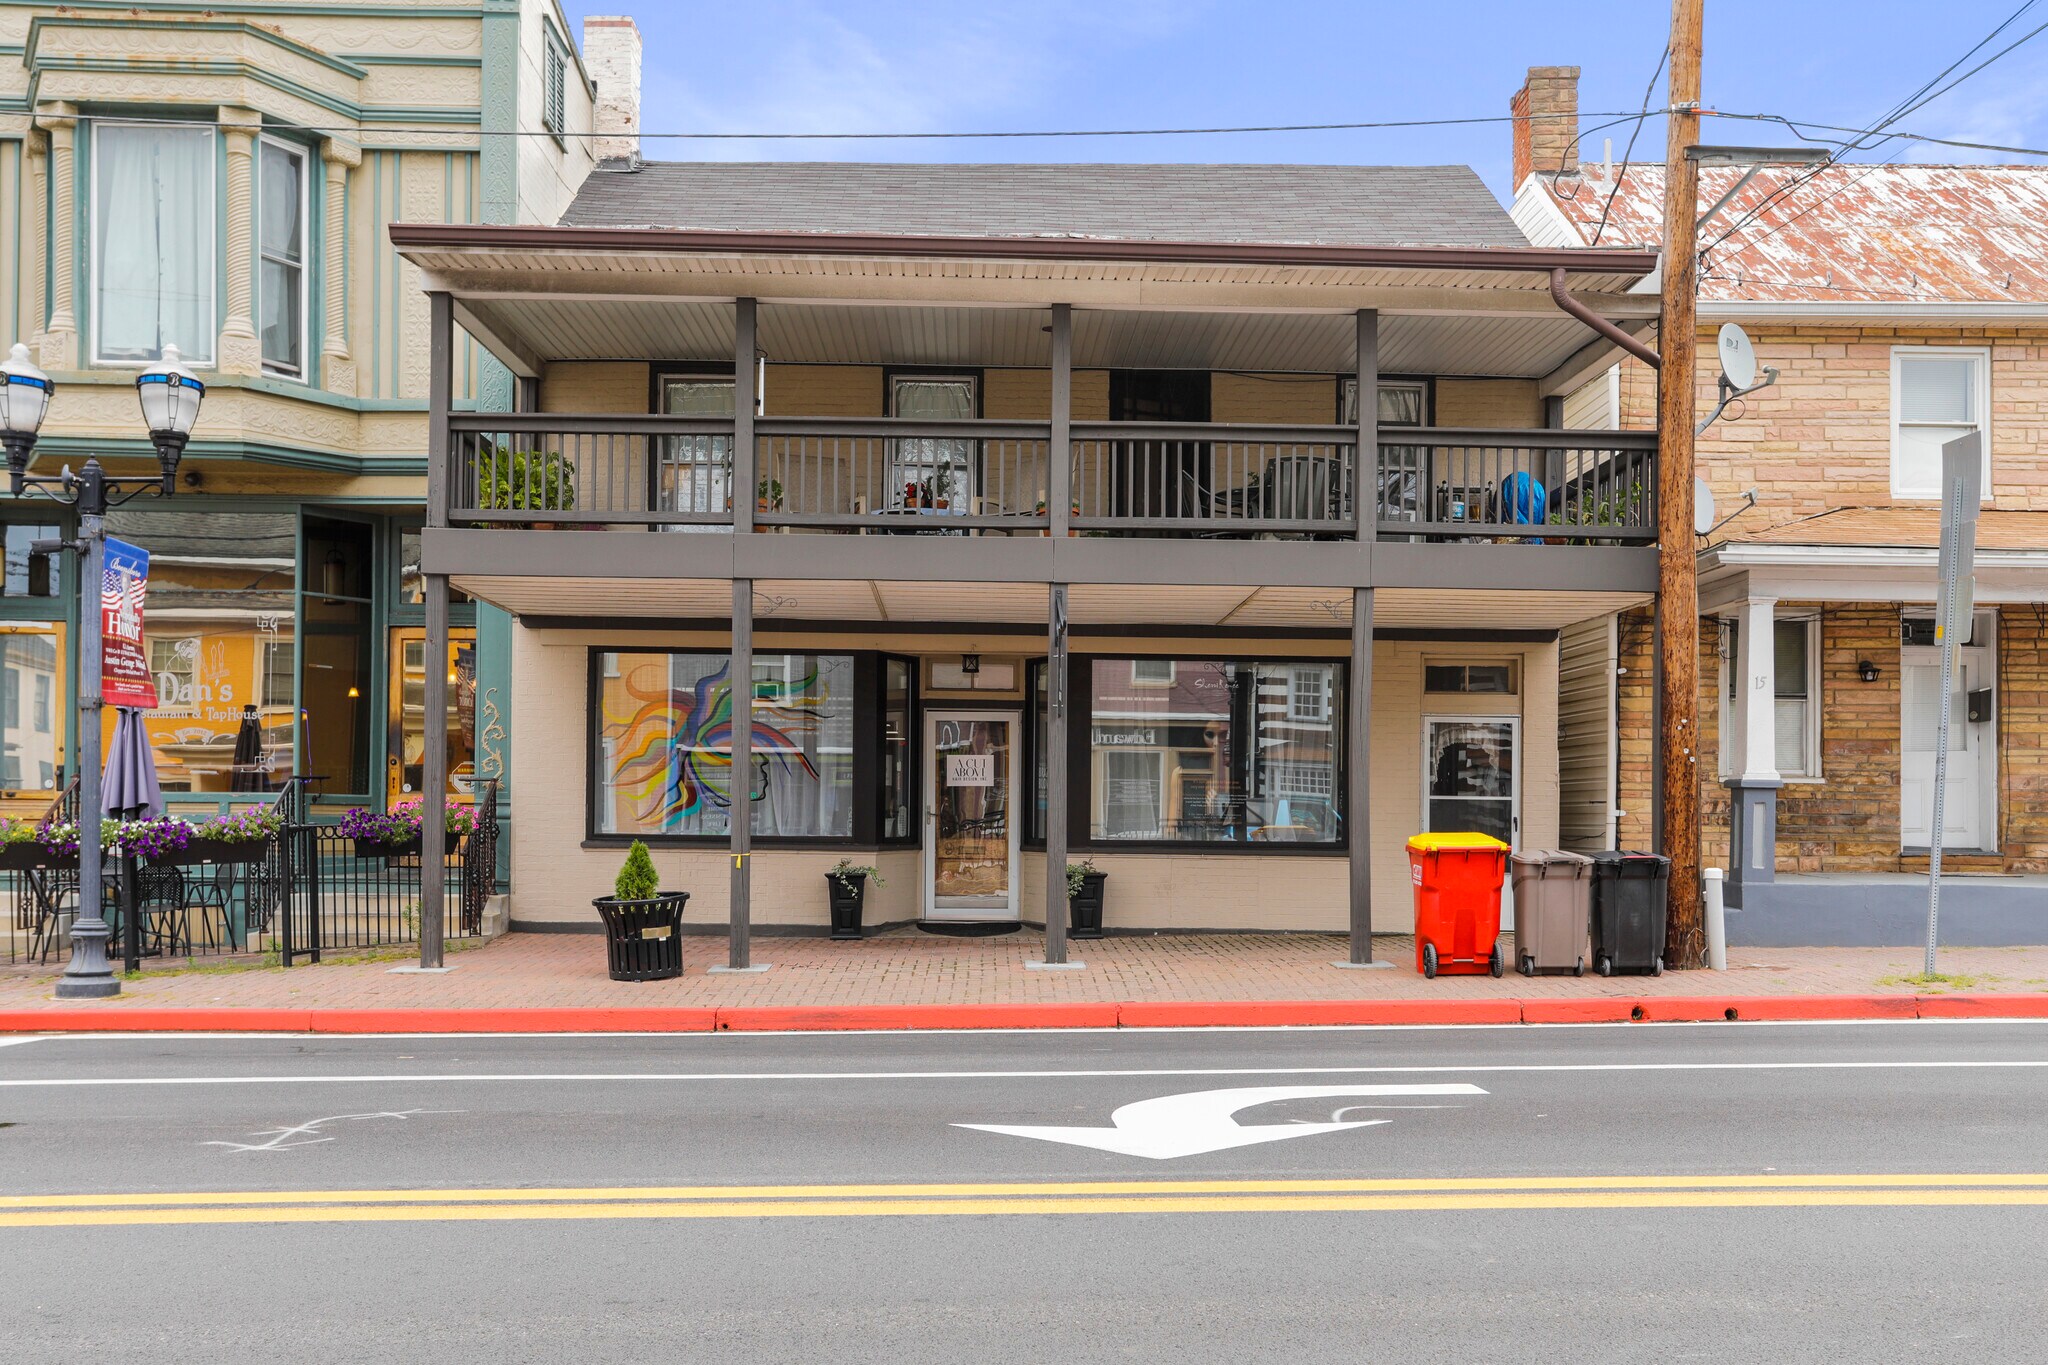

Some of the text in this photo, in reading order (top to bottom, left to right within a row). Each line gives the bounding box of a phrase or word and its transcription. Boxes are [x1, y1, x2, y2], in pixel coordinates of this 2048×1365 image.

[1755, 675, 1767, 690] 15
[157, 672, 233, 706] Dan's
[141, 709, 189, 719] staurant
[191, 710, 202, 719] &
[952, 767, 987, 777] ABOVE
